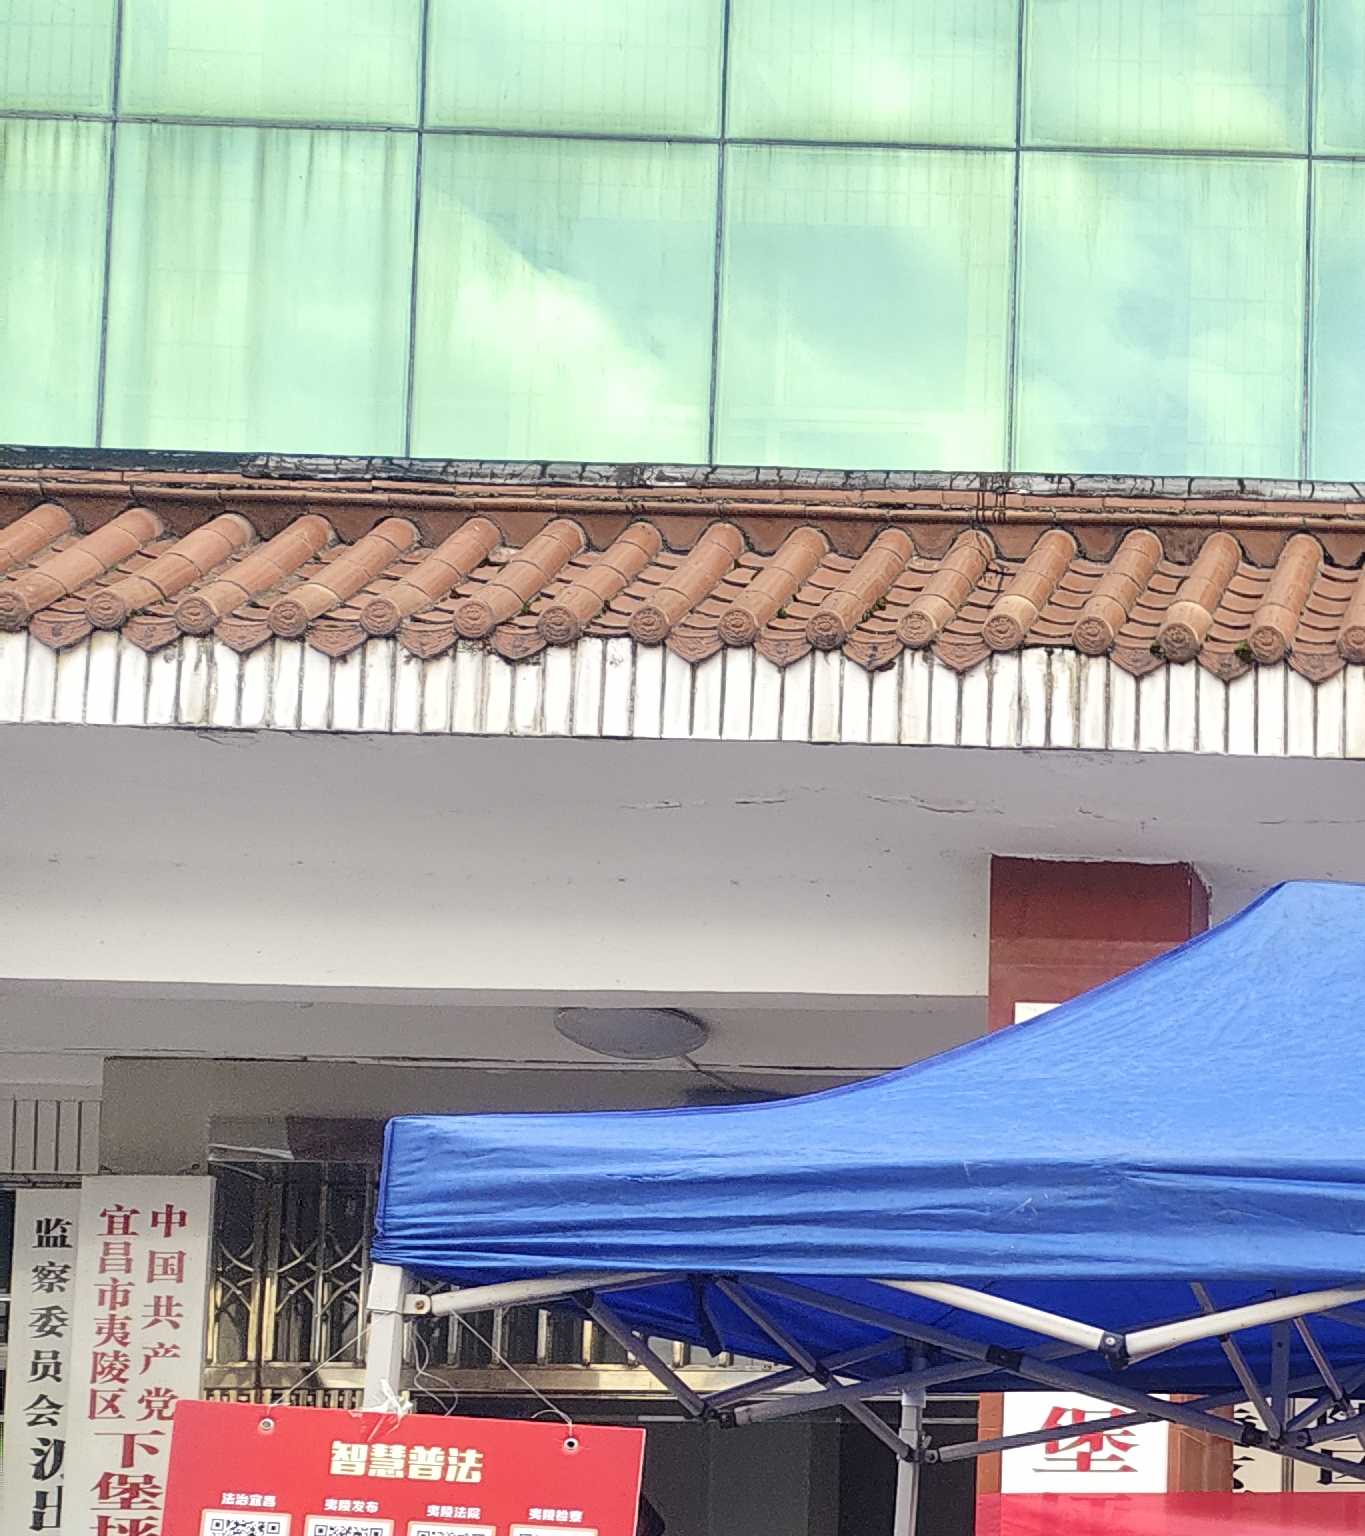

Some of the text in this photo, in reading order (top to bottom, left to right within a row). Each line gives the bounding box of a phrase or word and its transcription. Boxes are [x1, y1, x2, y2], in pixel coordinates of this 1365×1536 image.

[87, 1203, 141, 1421] 宜昌市夷陵区
[137, 1203, 188, 1421] 中国共产党
[1033, 1406, 1138, 1472] 堡
[329, 1440, 483, 1483] 智慧普法
[221, 1492, 276, 1508] 法治宜昌
[325, 1498, 379, 1514] 夷陵发布
[426, 1504, 481, 1521] 夷陵法院
[528, 1508, 583, 1523] 夷陵检察
